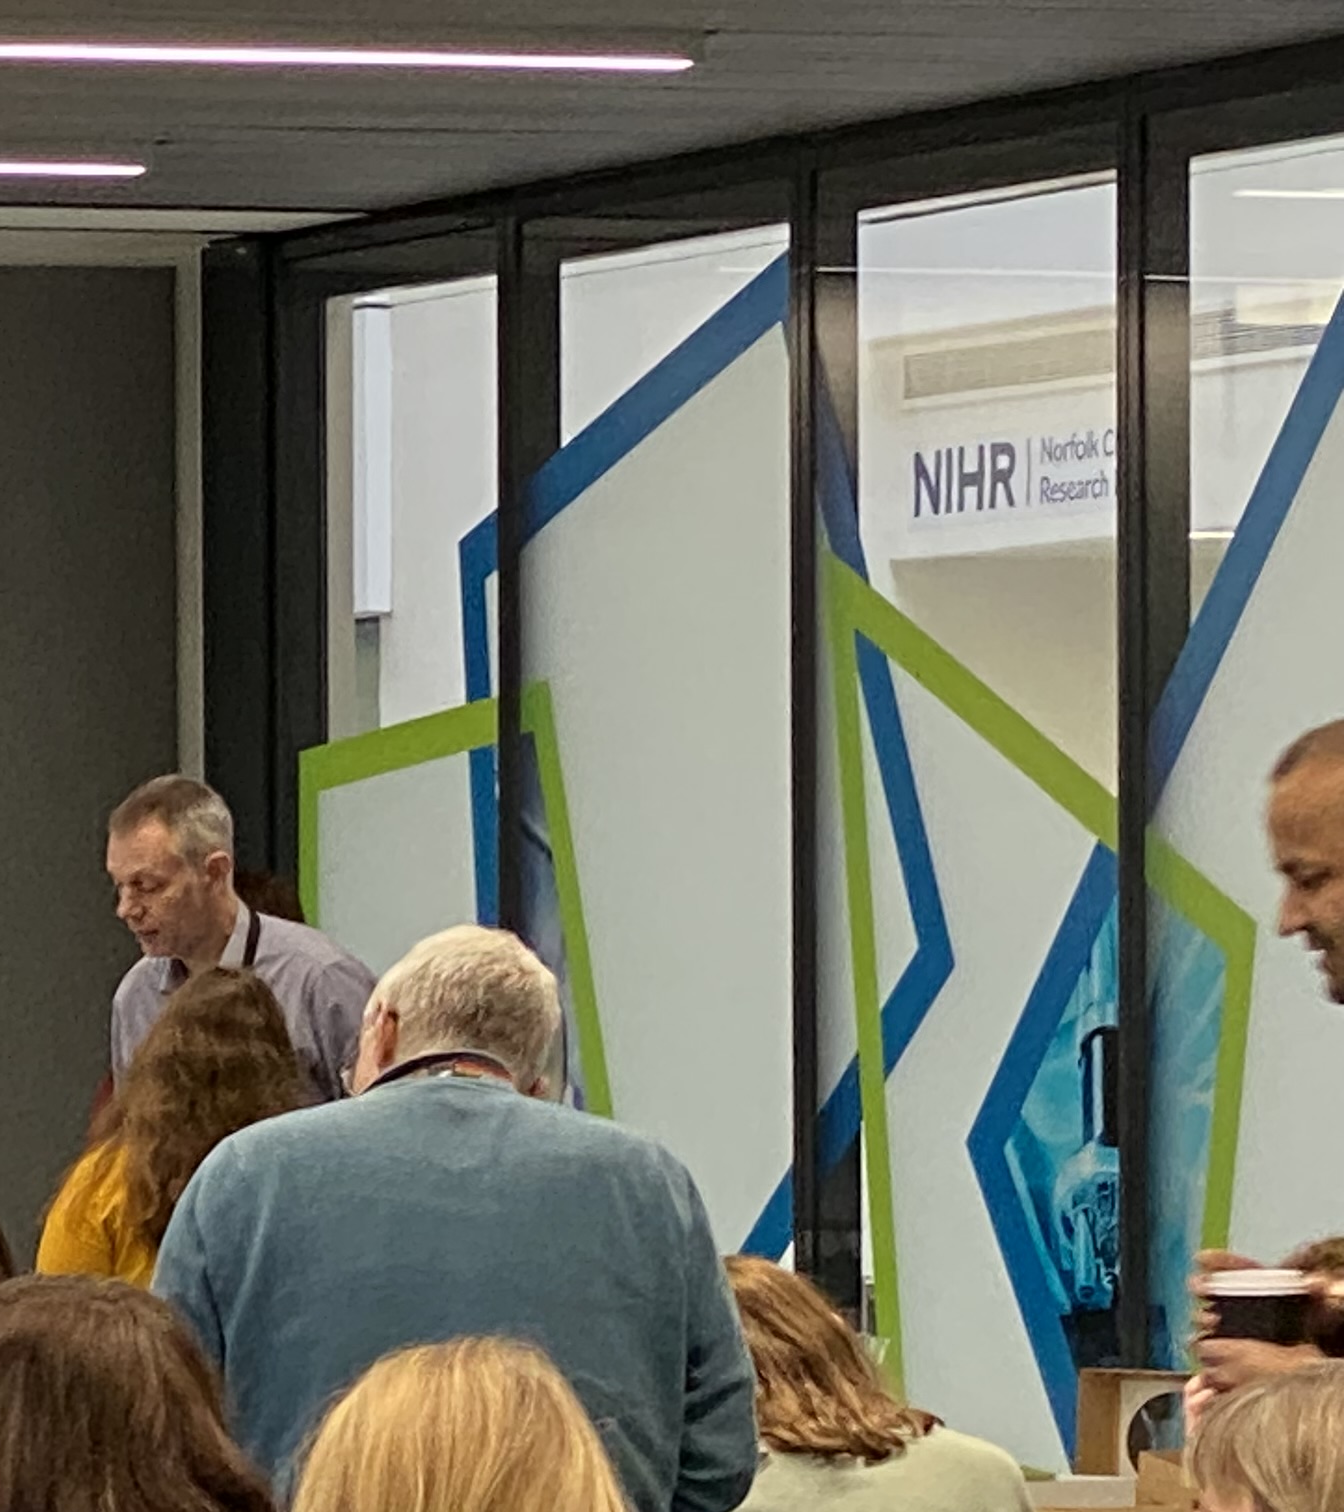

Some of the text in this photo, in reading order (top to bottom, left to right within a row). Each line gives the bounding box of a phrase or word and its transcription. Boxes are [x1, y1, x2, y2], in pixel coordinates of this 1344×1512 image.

[1040, 431, 1100, 465] Norfolk
[913, 442, 1016, 519] NIHR
[1040, 475, 1110, 505] Research
